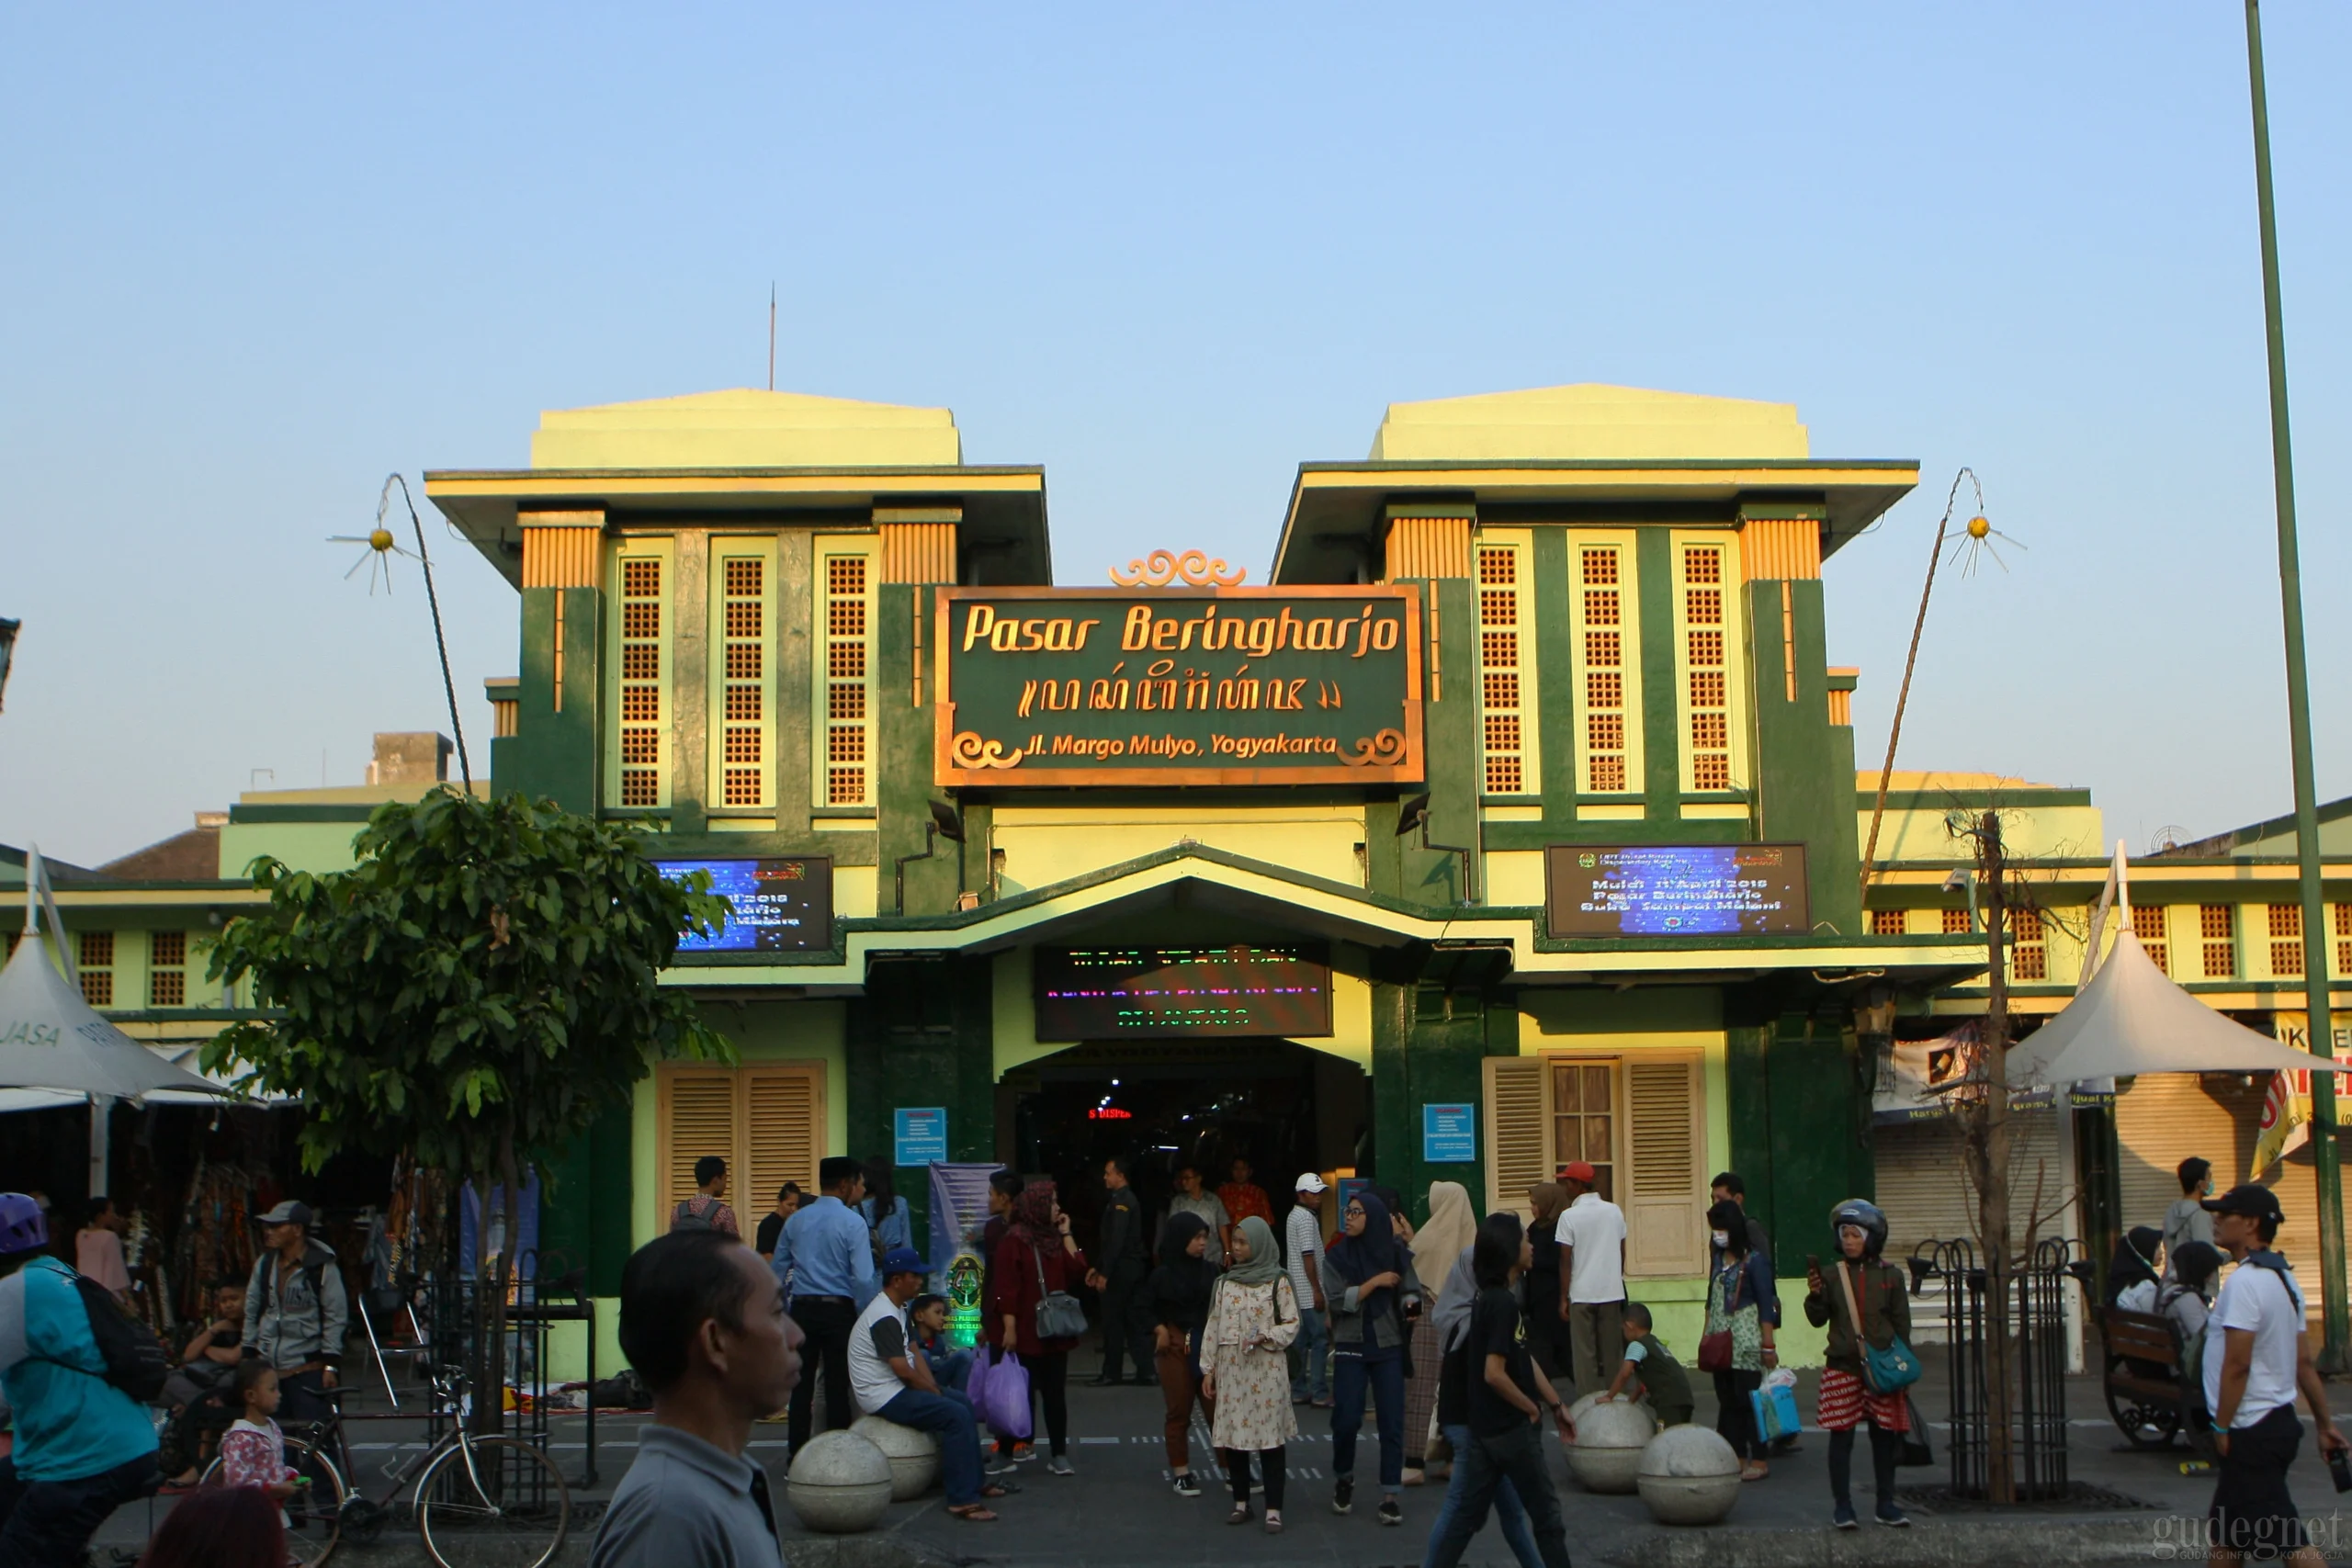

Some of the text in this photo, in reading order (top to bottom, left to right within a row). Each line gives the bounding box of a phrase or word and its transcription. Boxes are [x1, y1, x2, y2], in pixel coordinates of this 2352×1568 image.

[964, 603, 1399, 659] Pasar Beringharjo
[1023, 732, 1337, 761] Jl. Margo Mulyo, Yogyakarta
